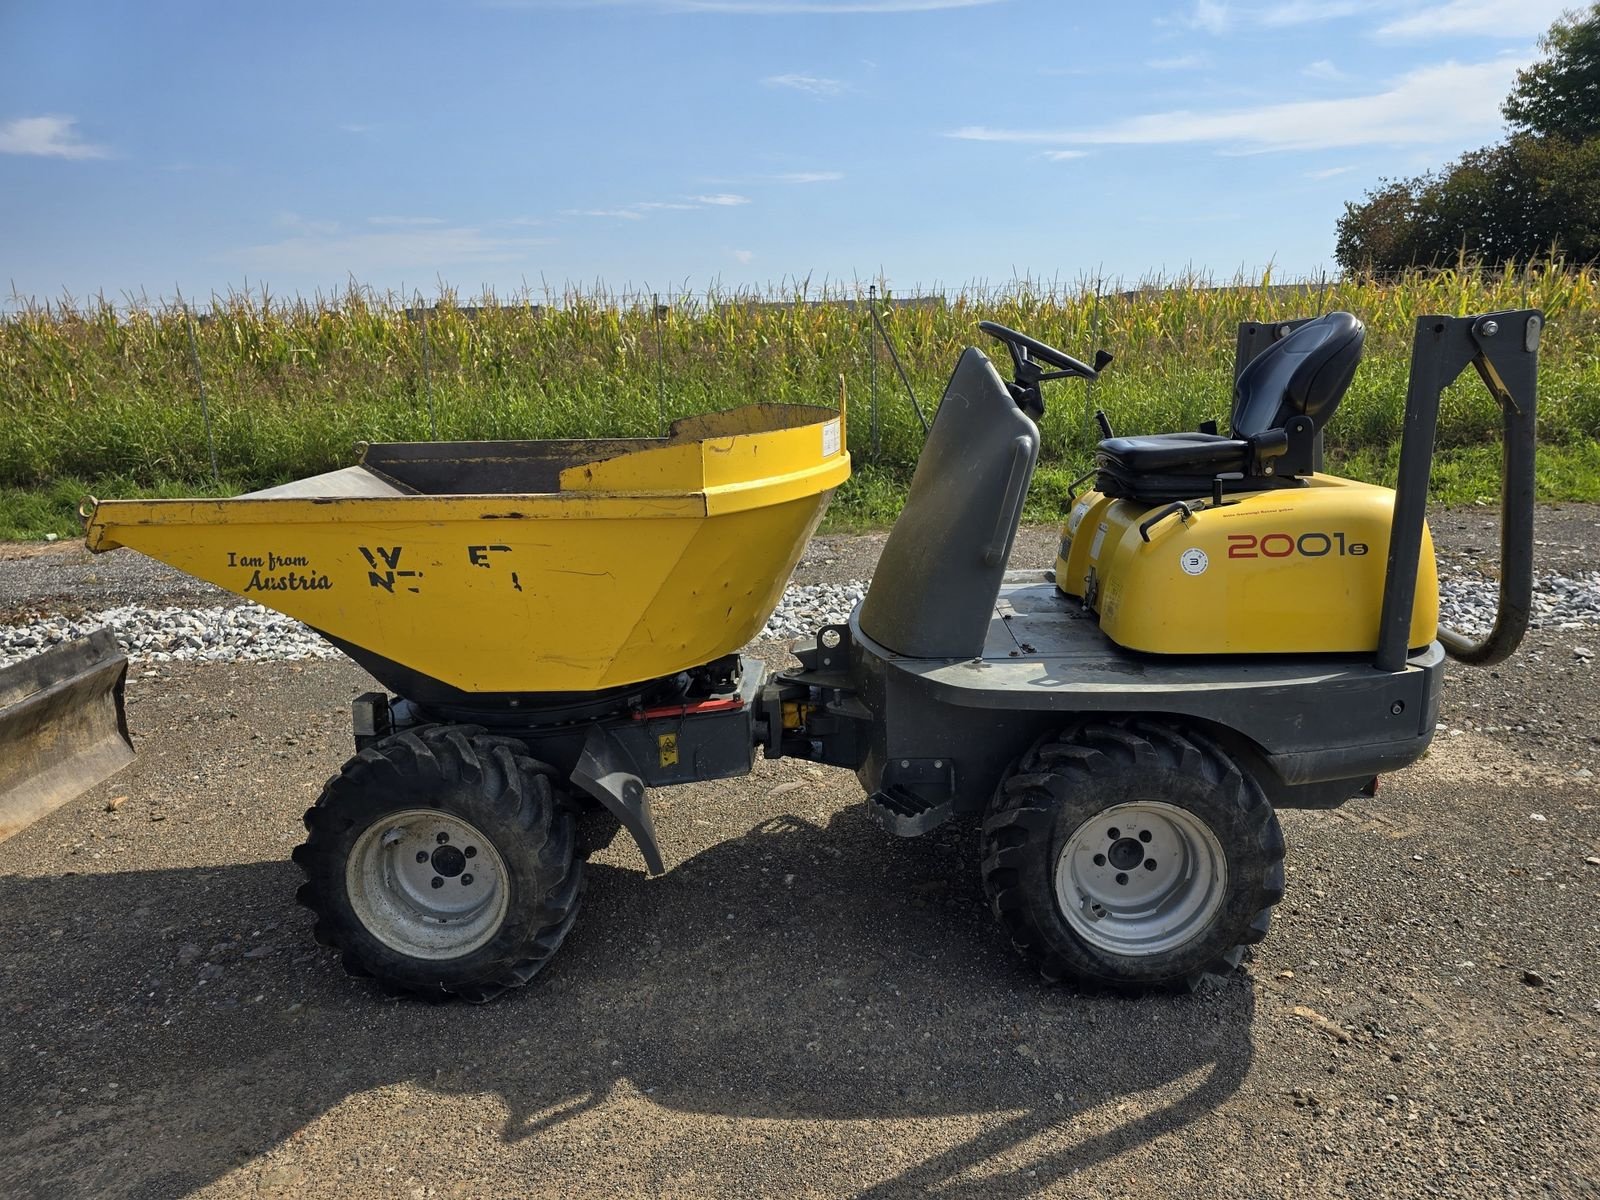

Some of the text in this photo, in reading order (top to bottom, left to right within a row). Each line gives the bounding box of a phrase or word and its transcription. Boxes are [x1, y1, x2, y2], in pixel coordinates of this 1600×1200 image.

[227, 551, 309, 571] I am from
[1189, 558, 1199, 566] 3
[243, 570, 333, 592] Austria
